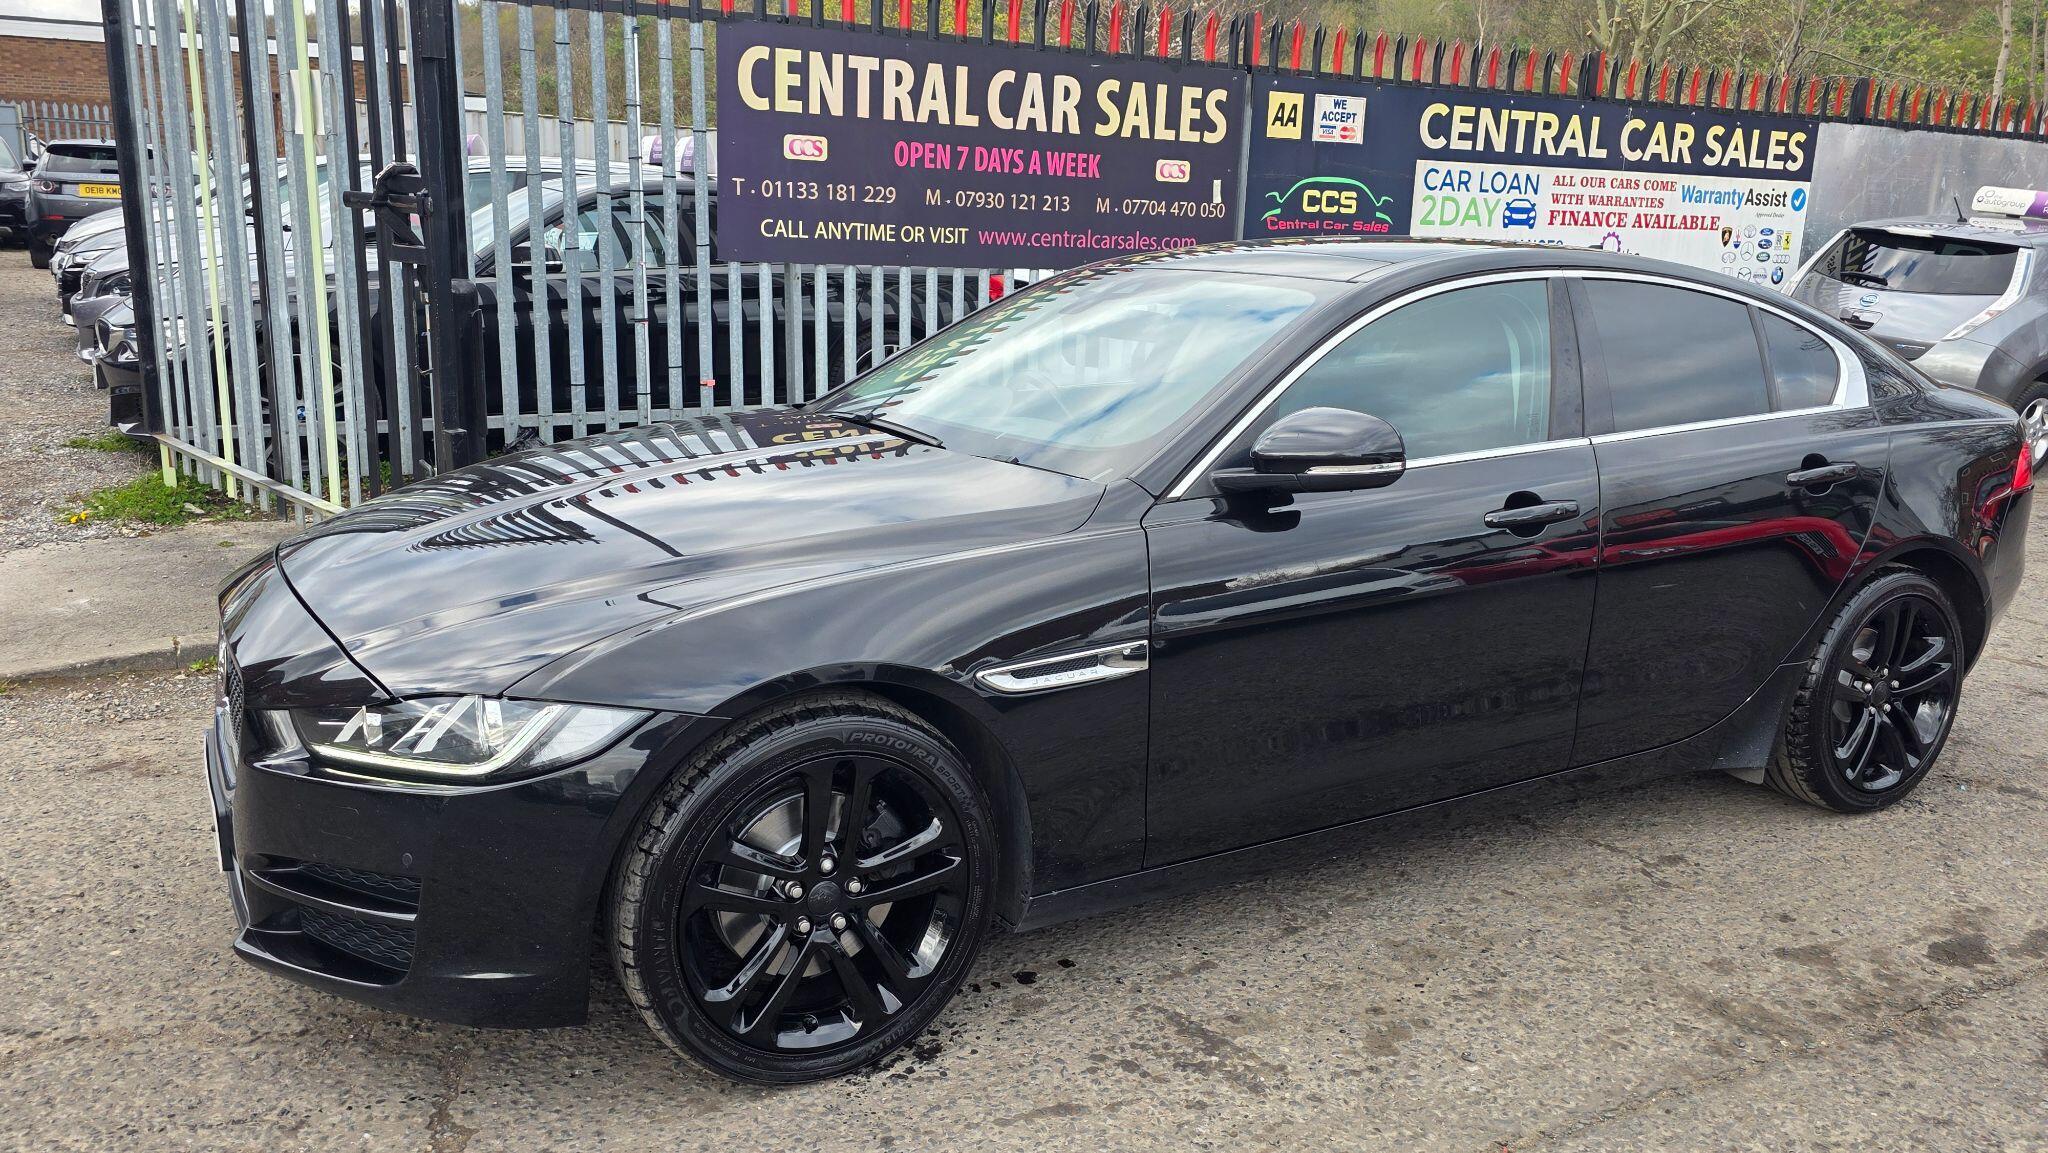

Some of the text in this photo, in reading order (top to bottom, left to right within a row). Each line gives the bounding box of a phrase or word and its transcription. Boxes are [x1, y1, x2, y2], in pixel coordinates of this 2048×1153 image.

[737, 45, 1228, 144] CENTRAL CAR SALES
[1334, 99, 1347, 110] WE
[1271, 103, 1298, 127] AA
[1321, 111, 1357, 124] ACCEPT
[789, 138, 823, 157] CCS
[1419, 103, 1807, 172] CENTRAL CAR SALES
[894, 141, 1101, 178] OPEN 7 DAYS A WEEK
[1160, 163, 1186, 179] CCS
[1423, 168, 1540, 195] CAR LOAN
[761, 179, 819, 200] 01133
[827, 184, 855, 201] 181
[863, 186, 896, 203] 229
[1552, 175, 1677, 192] ALL OUR CARS COME
[955, 191, 1005, 209] 07930
[1010, 193, 1035, 210] 121
[1043, 195, 1070, 212] 213
[1123, 199, 1166, 216] 07704
[1170, 201, 1196, 217] 470
[1200, 202, 1225, 218] 050
[1303, 190, 1357, 214] CCS
[1419, 194, 1502, 227] 2DAY
[1551, 193, 1664, 208] WITH WARRANTIES
[1266, 217, 1389, 233] Central Car Sales
[1548, 210, 1720, 231] FINANCE AVAILABLE
[760, 219, 1196, 250] CALL ANYTIME OR VISIT www.centralcarsales.com
[1032, 669, 1098, 685] JAGUAR
[850, 732, 937, 766] PROTOURA
[936, 765, 966, 795] SPORT
